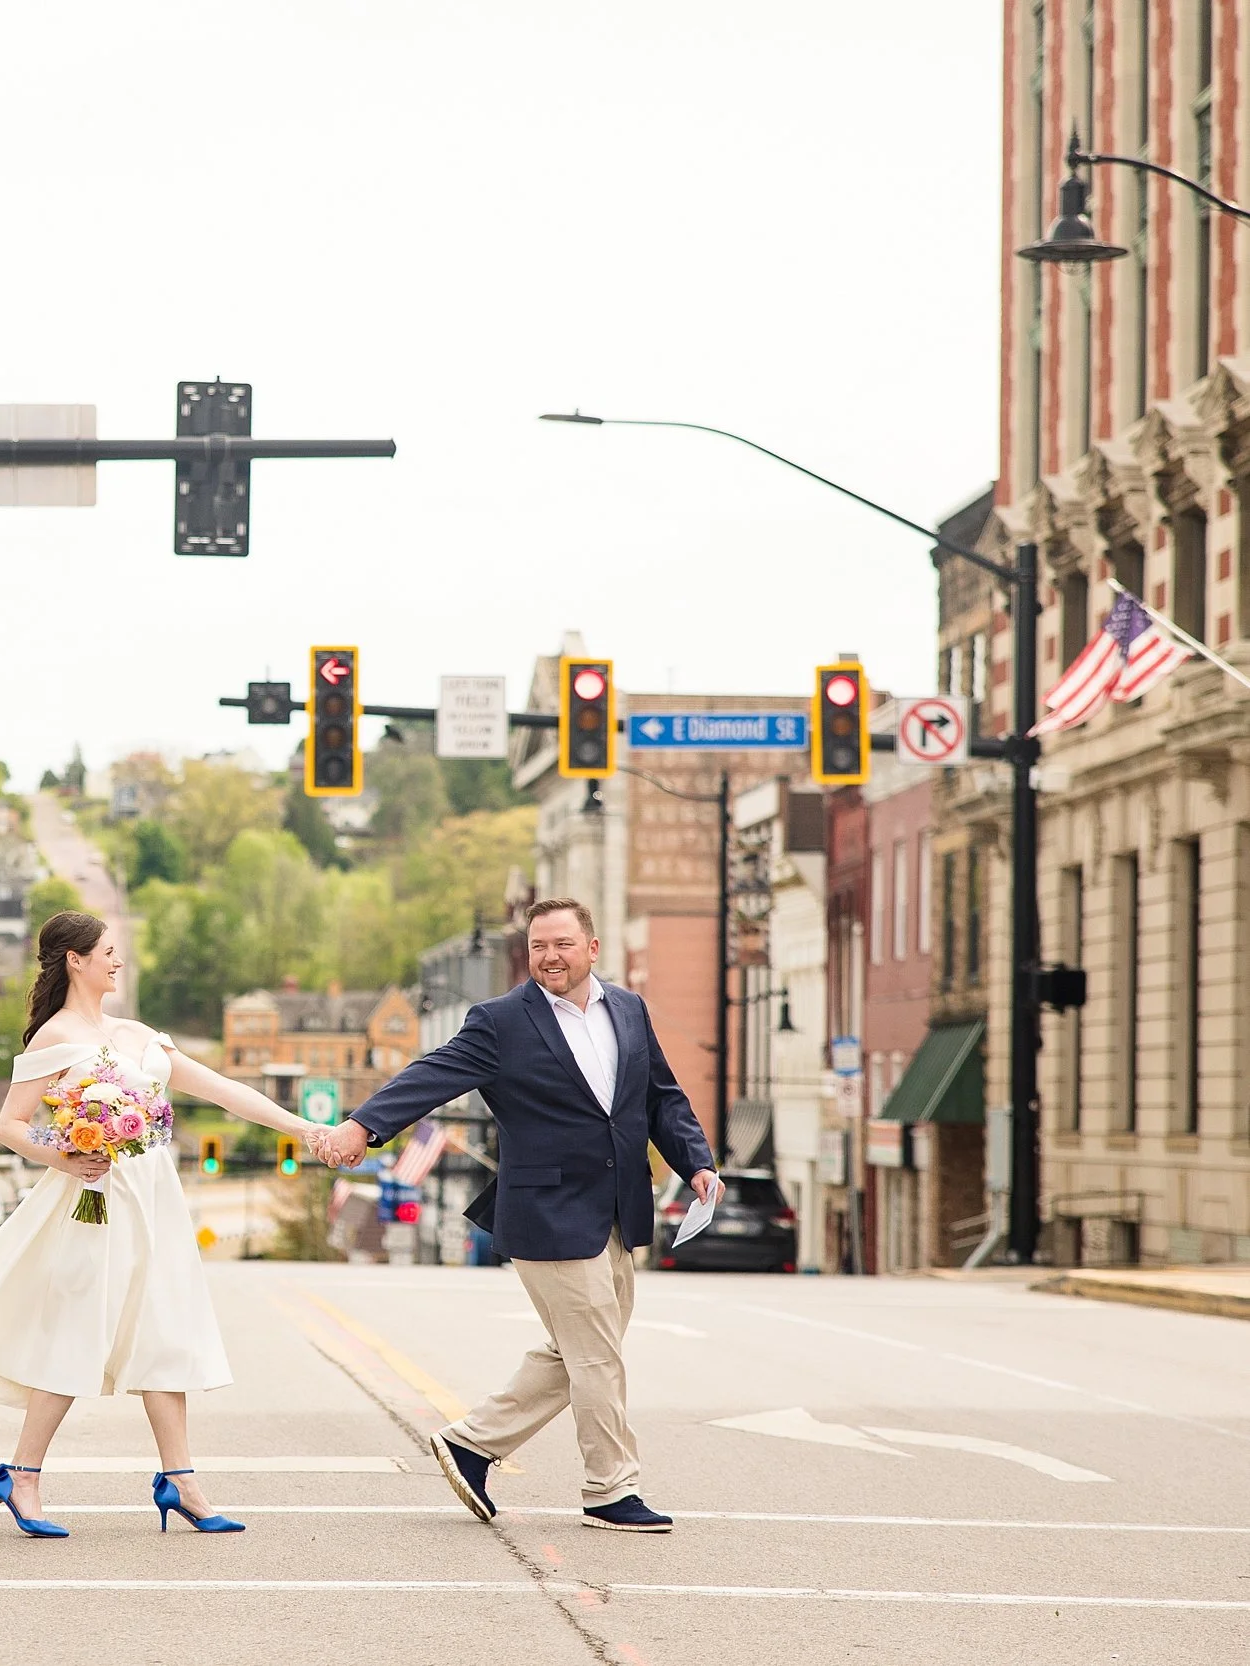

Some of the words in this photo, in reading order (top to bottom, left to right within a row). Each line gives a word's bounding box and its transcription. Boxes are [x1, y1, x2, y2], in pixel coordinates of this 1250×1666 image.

[672, 717, 686, 741] E
[688, 717, 768, 741] Diamond
[775, 717, 798, 741] St
